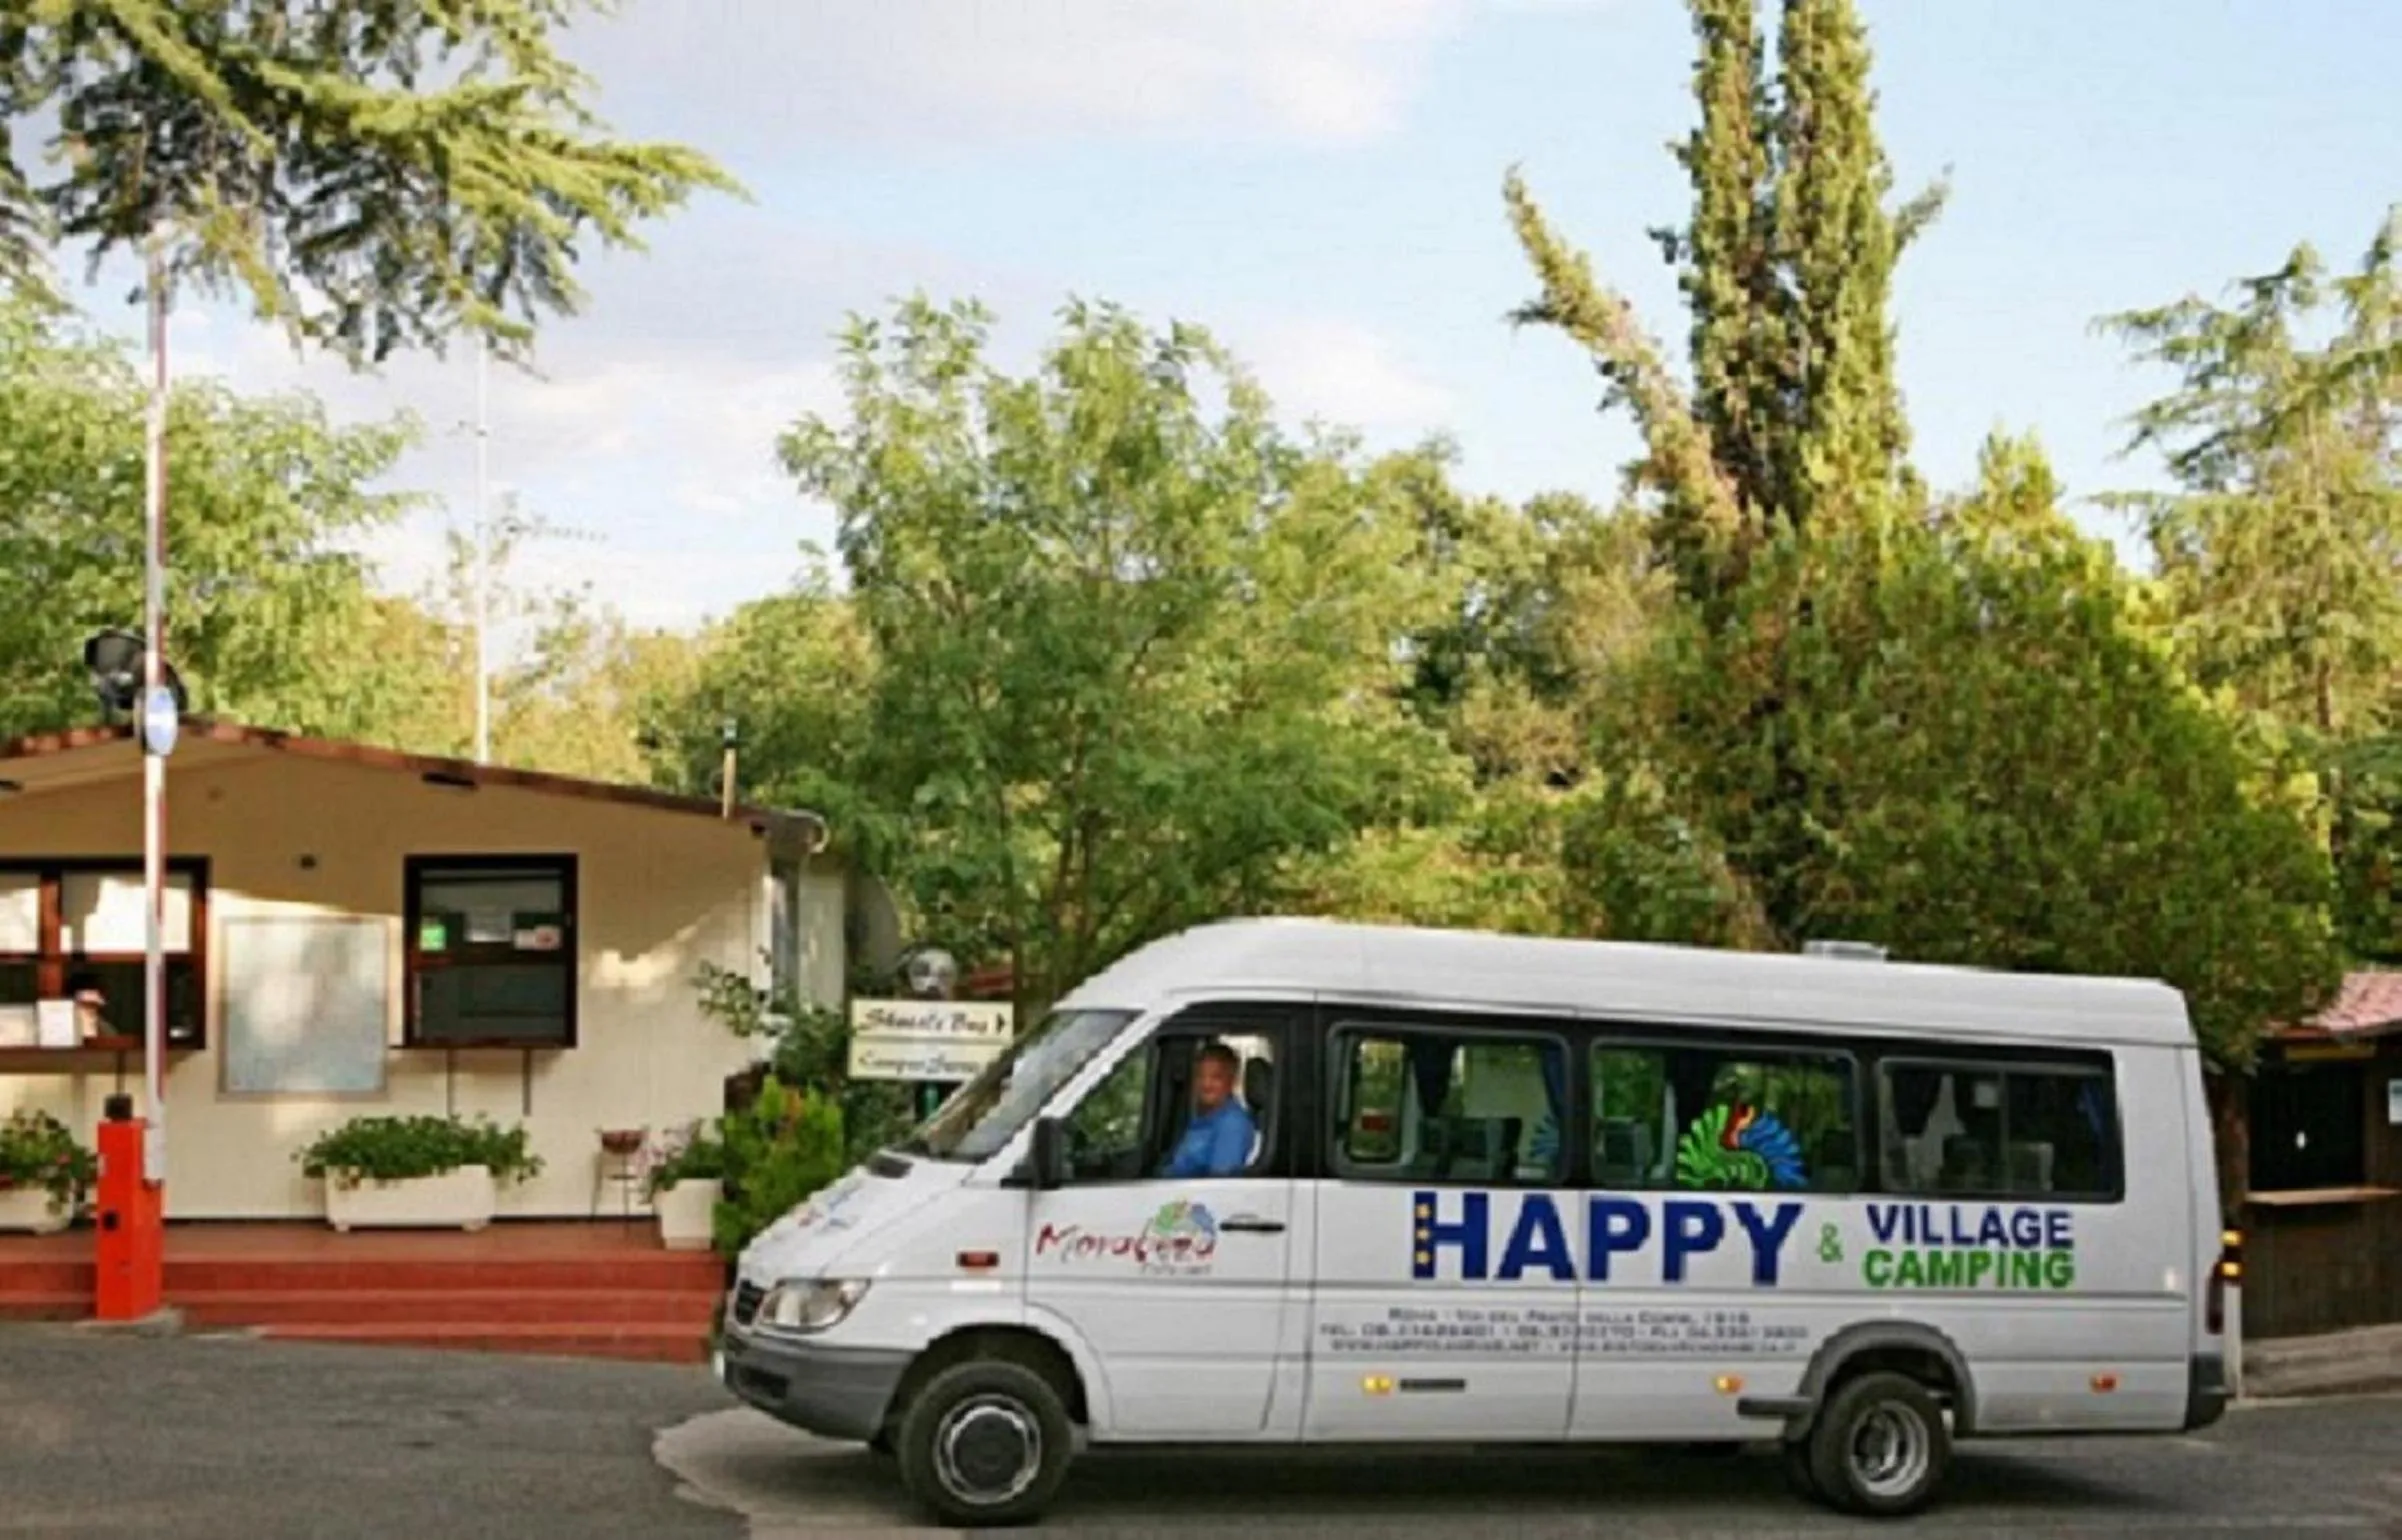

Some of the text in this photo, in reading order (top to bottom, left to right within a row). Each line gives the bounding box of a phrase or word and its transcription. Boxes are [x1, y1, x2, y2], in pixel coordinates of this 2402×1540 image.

[1412, 1190, 1804, 1287] HAPPY
[1815, 1221, 1844, 1263] &
[1864, 1202, 2075, 1250] VILLAGE
[1862, 1247, 2076, 1289] CAMPING
